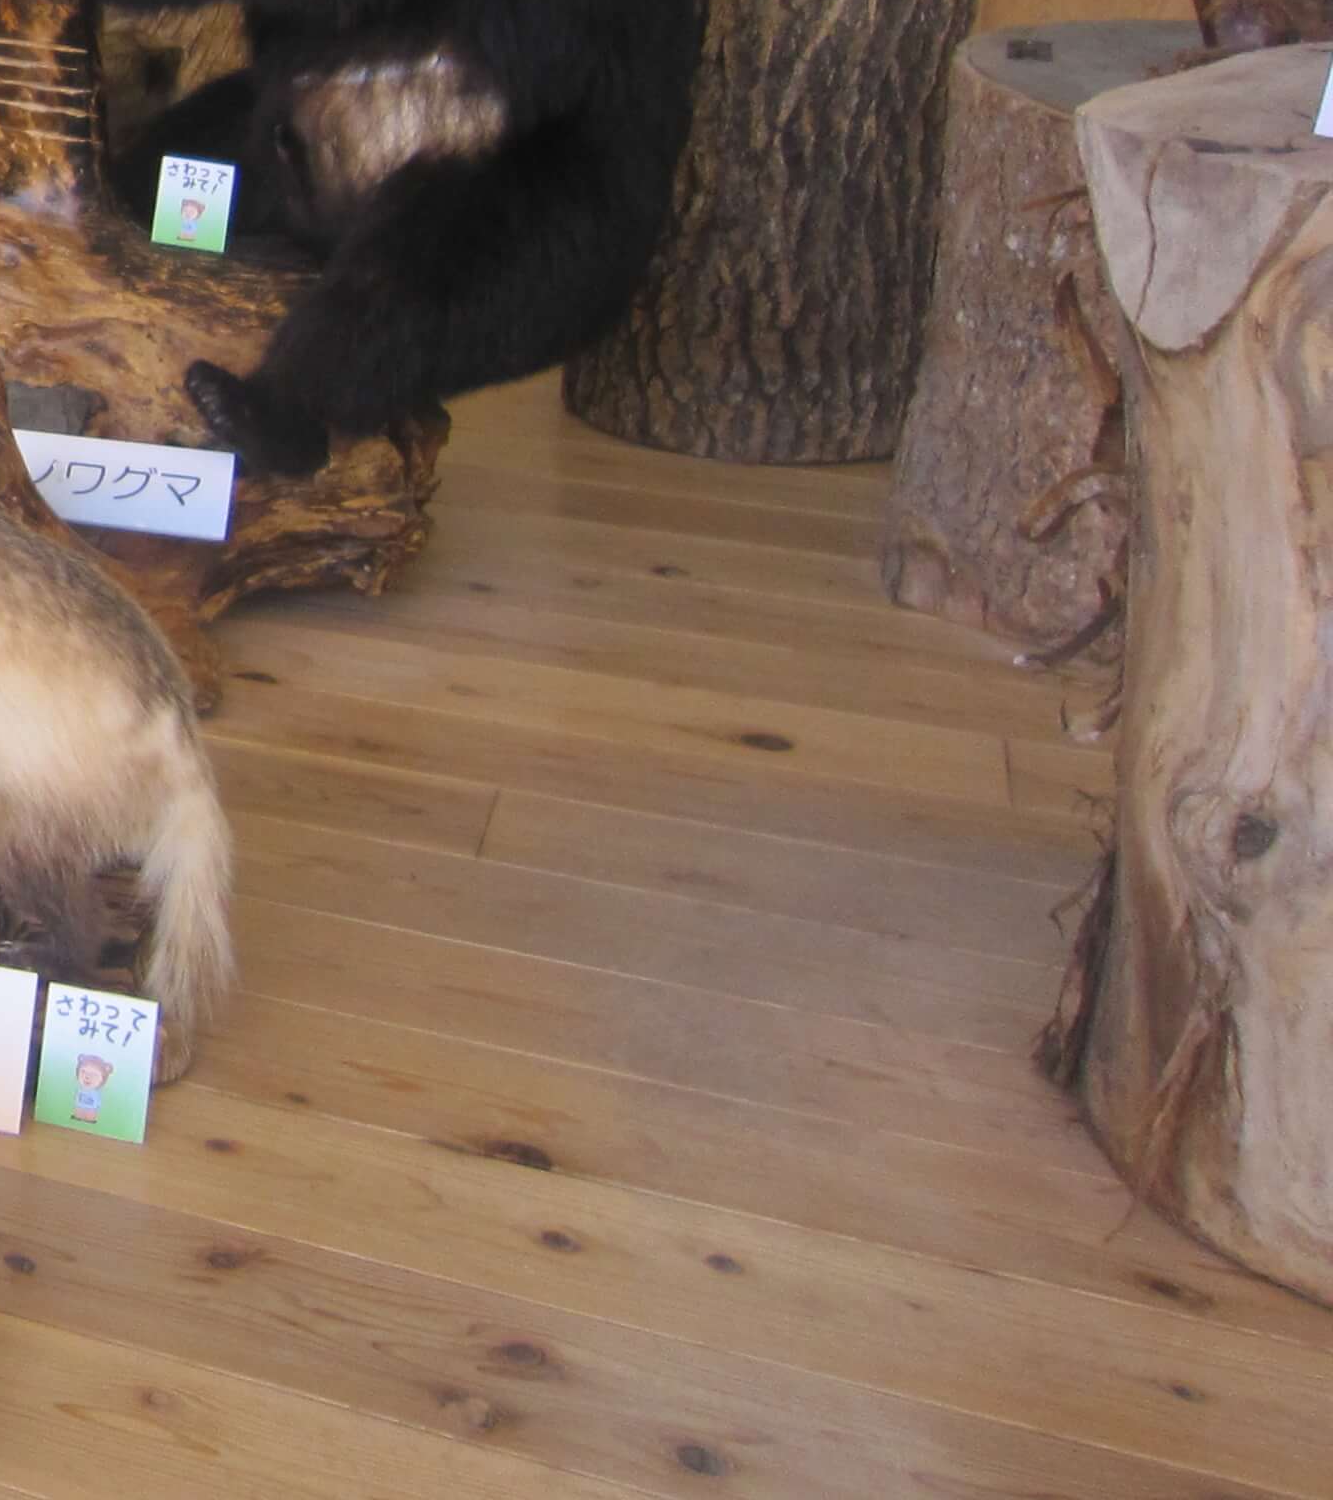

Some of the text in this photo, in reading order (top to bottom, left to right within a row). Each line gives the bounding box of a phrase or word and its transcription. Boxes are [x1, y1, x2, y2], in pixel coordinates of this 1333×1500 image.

[166, 162, 229, 184] さわって
[56, 995, 148, 1032] さわって
